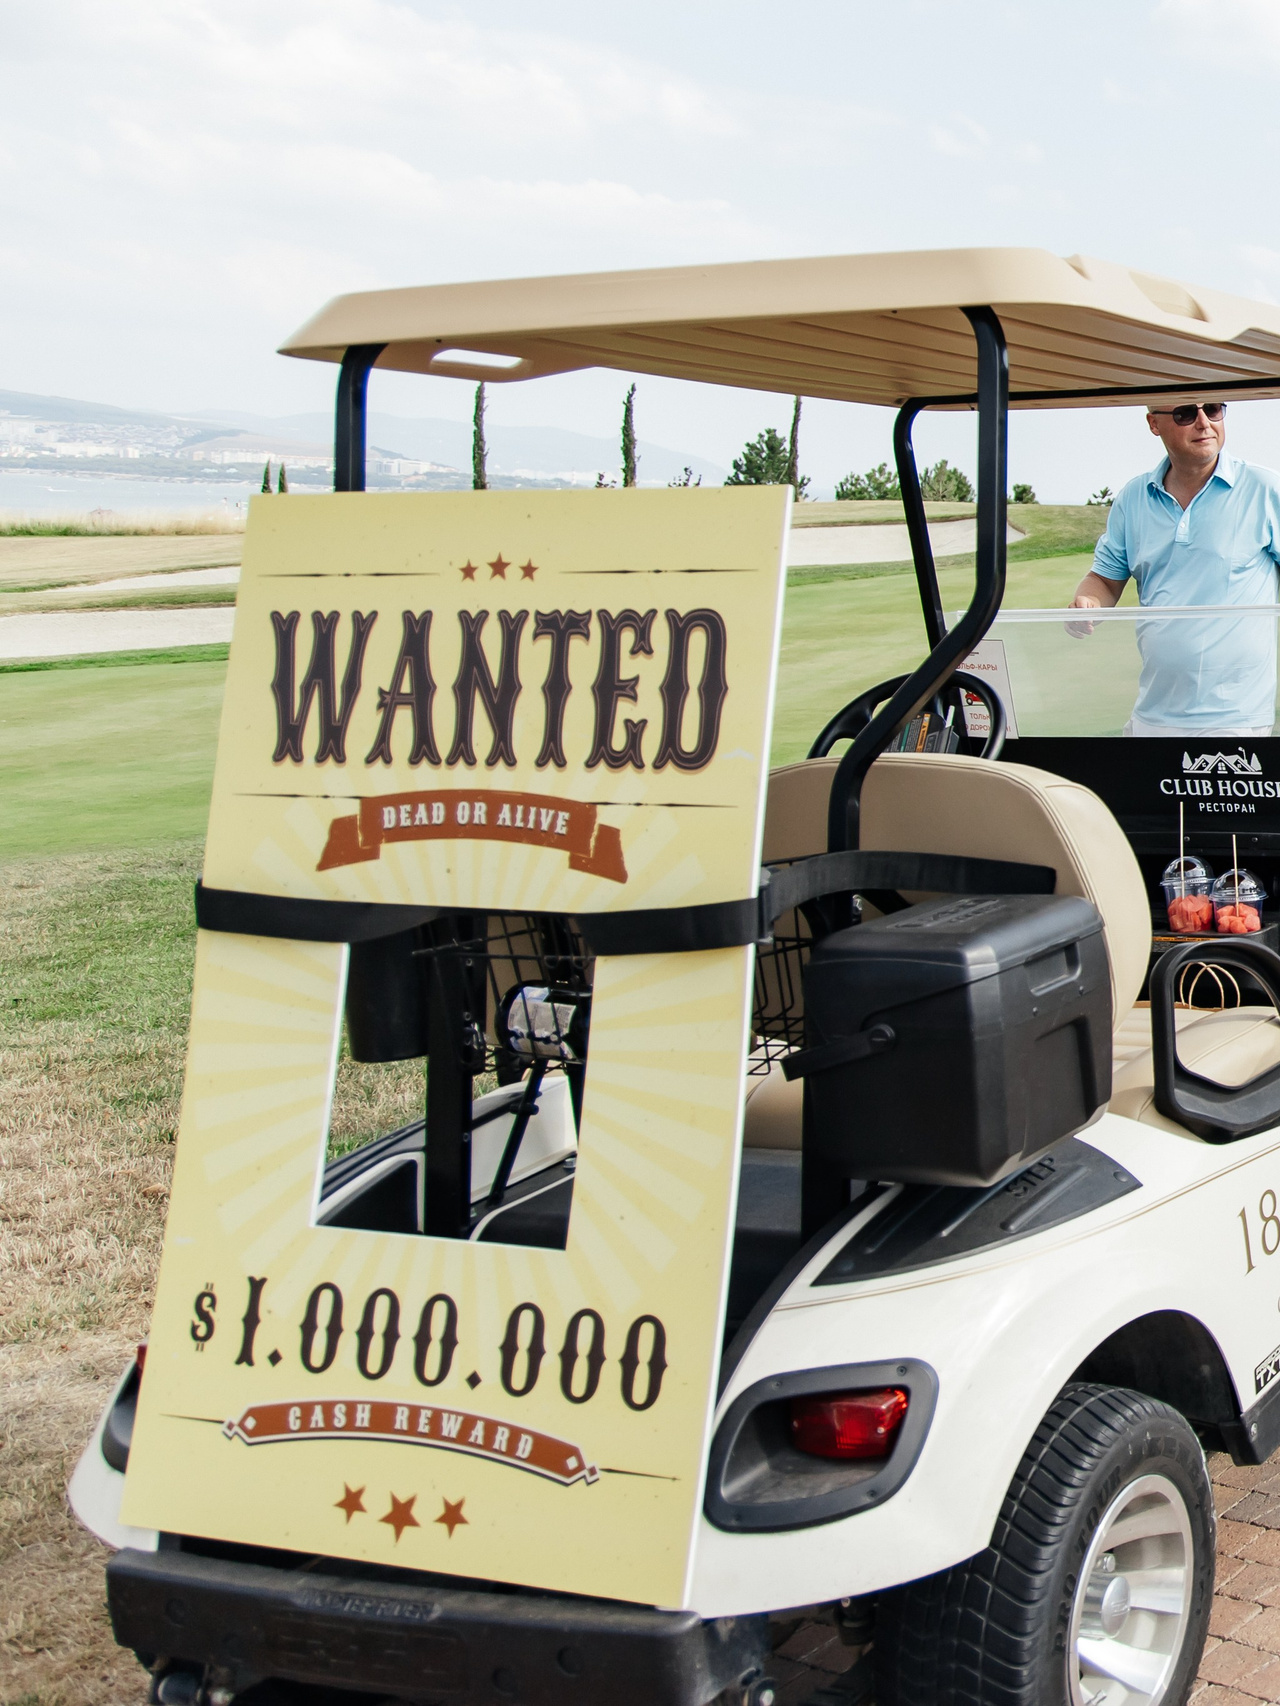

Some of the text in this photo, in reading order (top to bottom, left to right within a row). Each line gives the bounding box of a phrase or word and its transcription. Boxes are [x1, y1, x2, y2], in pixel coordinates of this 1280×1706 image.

[957, 662, 998, 671] ЛЬФ-КАРЫ
[269, 607, 729, 772] WANTED
[1160, 779, 1213, 797] CLUB
[382, 801, 570, 836] DEAD OR ALIVE
[1199, 802, 1256, 813] РЕСТОРАН
[1006, 1156, 1056, 1197] STEP
[190, 1275, 668, 1412] $1.000.000
[288, 1403, 534, 1461] CASH REWARD
